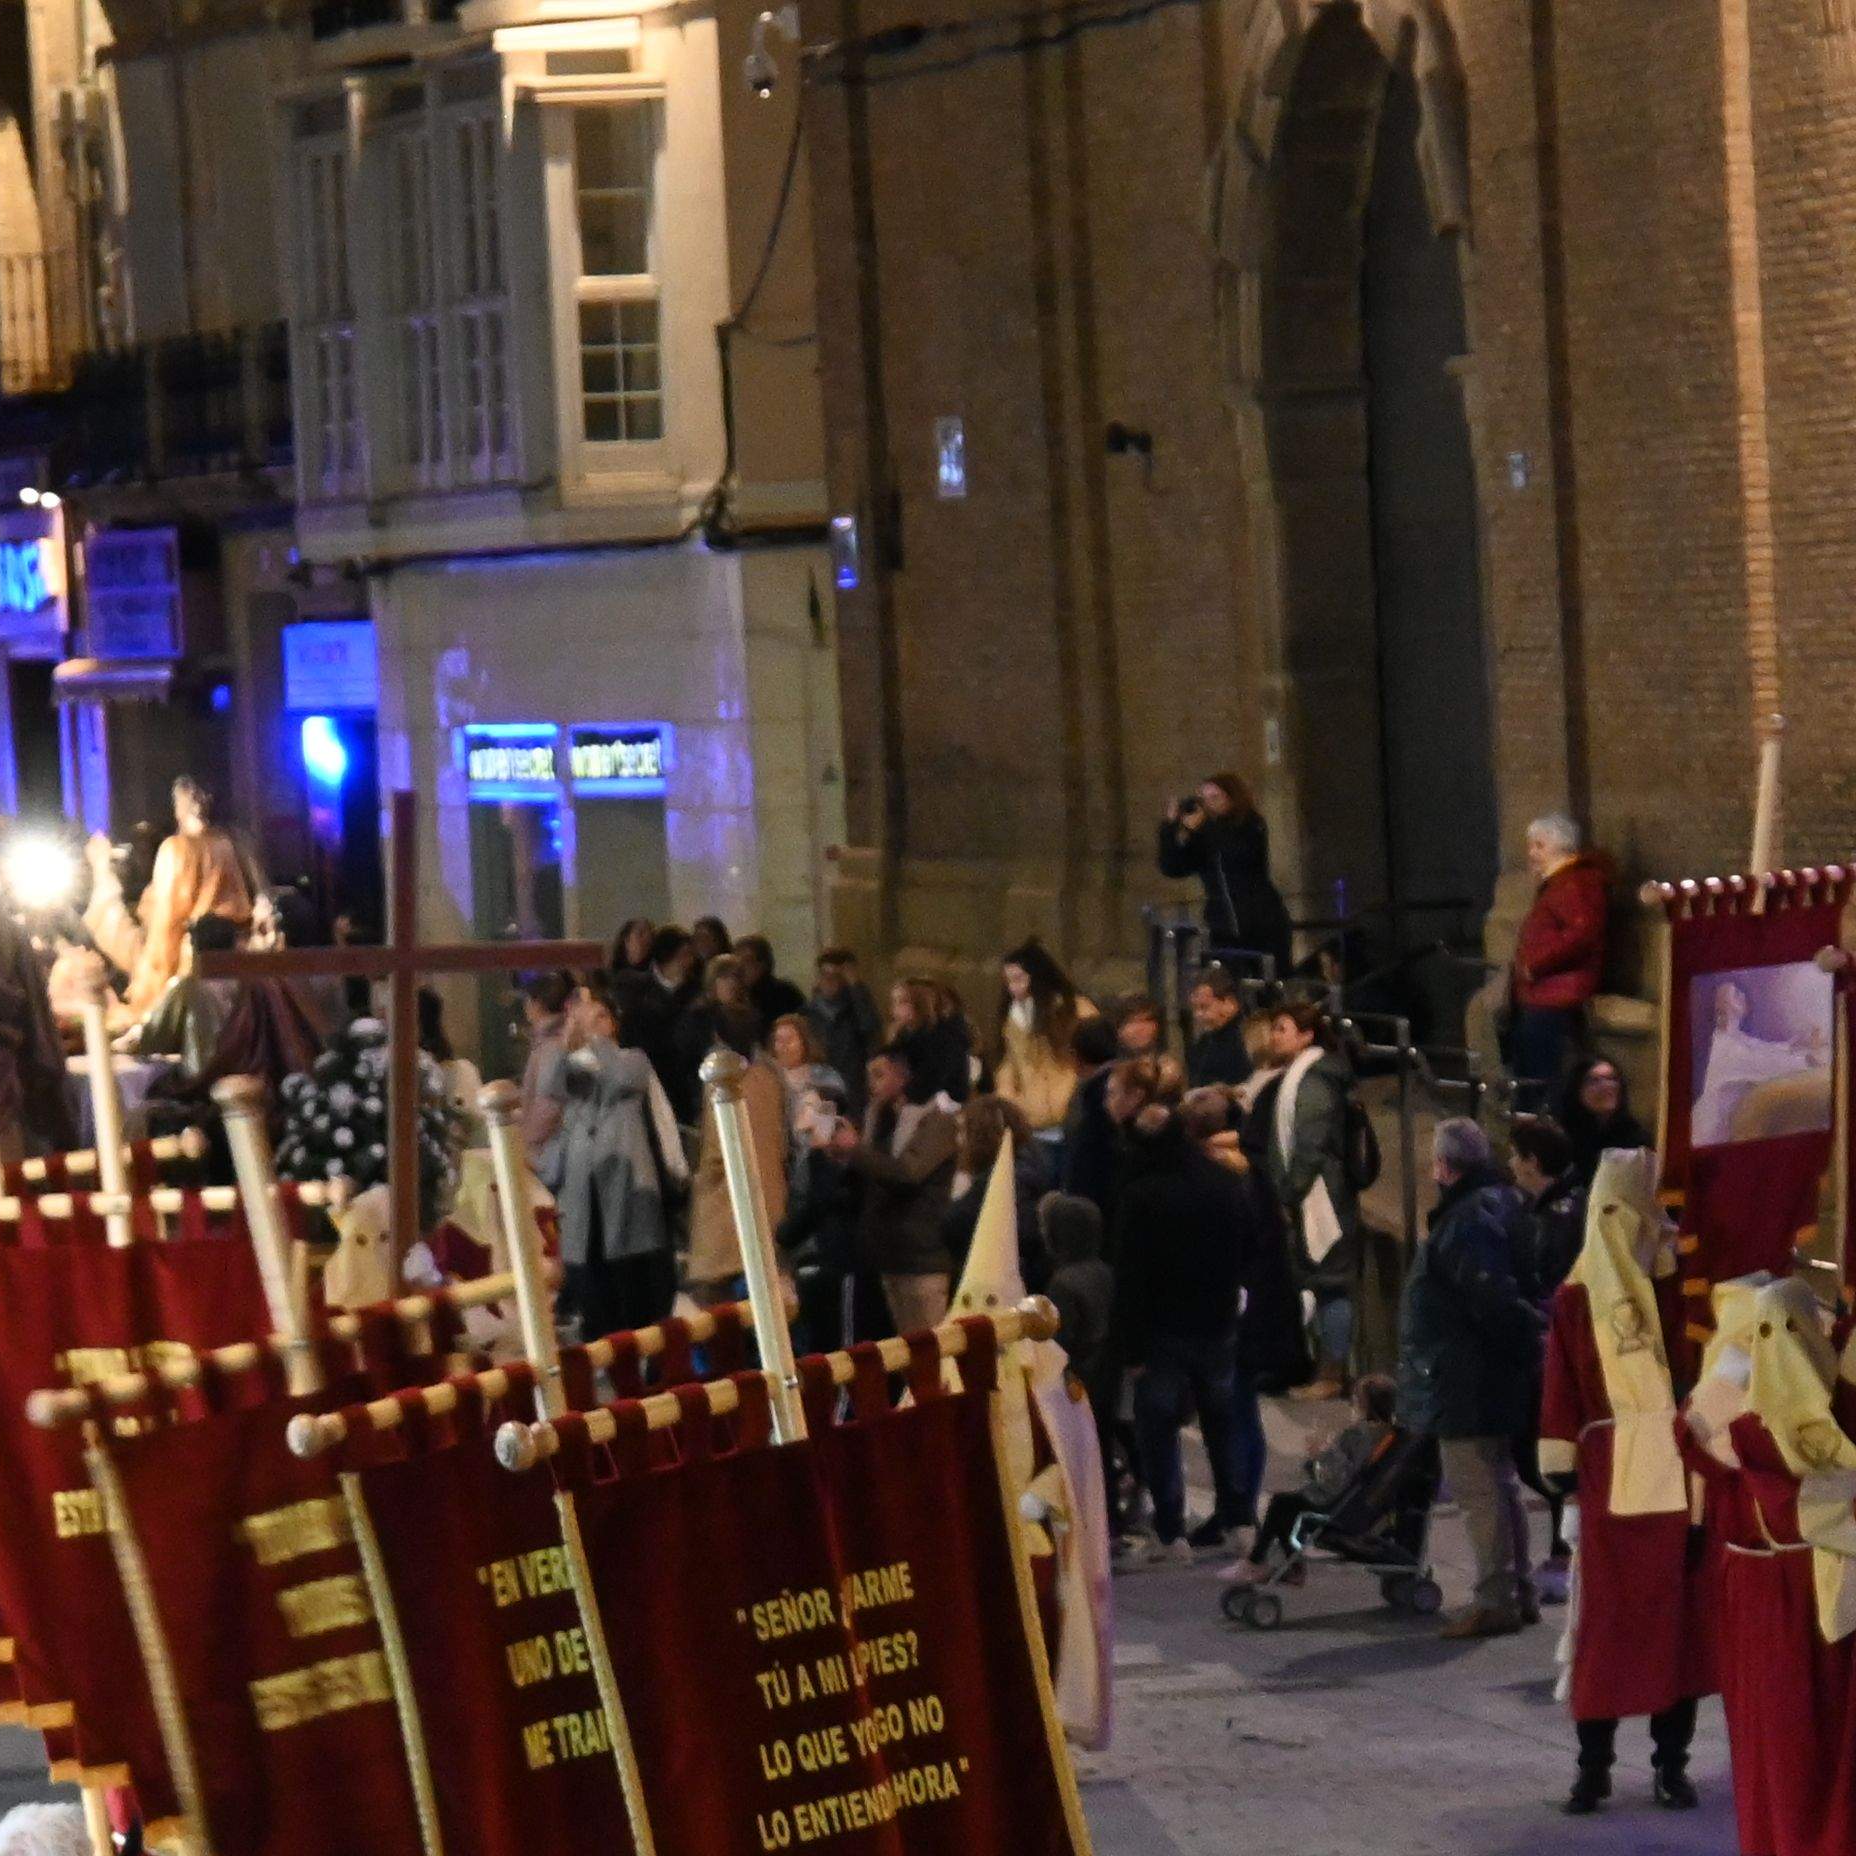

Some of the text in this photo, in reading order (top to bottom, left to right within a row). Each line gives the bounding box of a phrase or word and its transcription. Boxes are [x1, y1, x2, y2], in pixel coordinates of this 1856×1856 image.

[755, 1659, 792, 1711] TÚ
[797, 1662, 817, 1701] A
[816, 1653, 850, 1697] MI
[758, 1737, 794, 1782] LO
[796, 1724, 850, 1773] QUE
[907, 1693, 945, 1737] NO
[756, 1808, 792, 1851] LO
